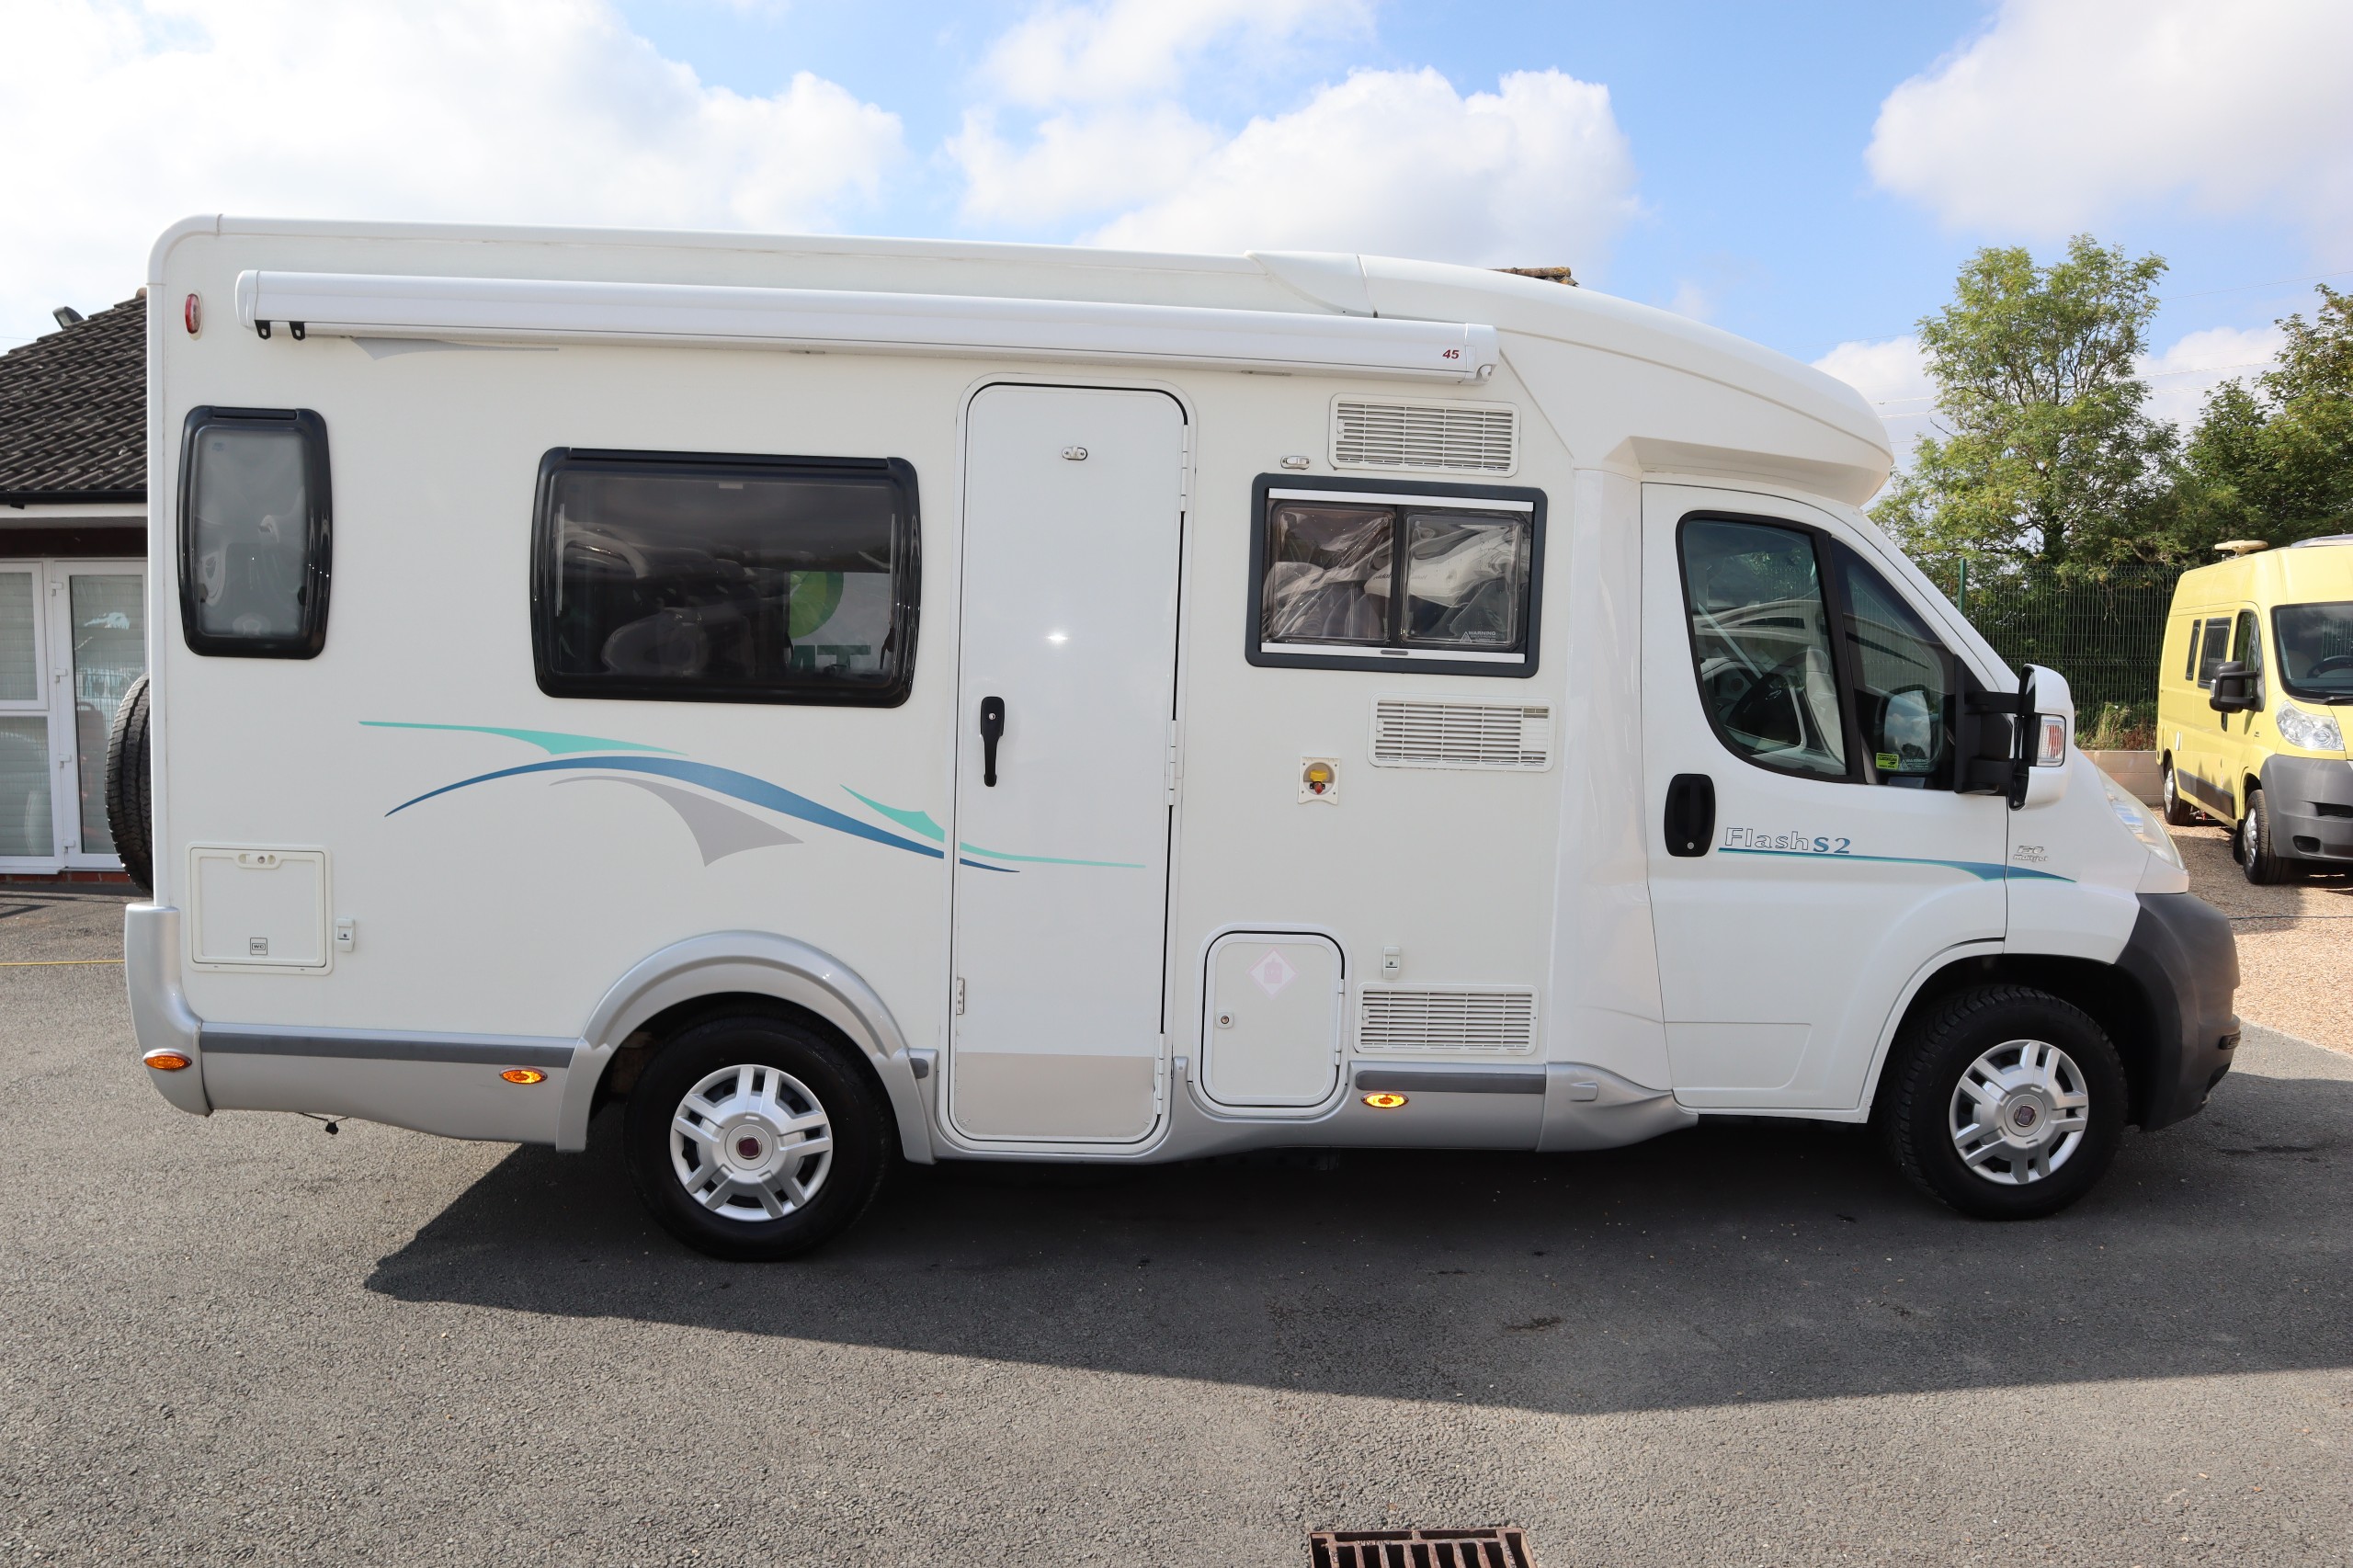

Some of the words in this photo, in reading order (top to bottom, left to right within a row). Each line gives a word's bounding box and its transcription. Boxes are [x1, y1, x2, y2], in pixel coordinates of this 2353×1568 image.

[1442, 349, 1460, 359] 45
[1724, 827, 1809, 851] Flash
[1813, 836, 1851, 855] S2
